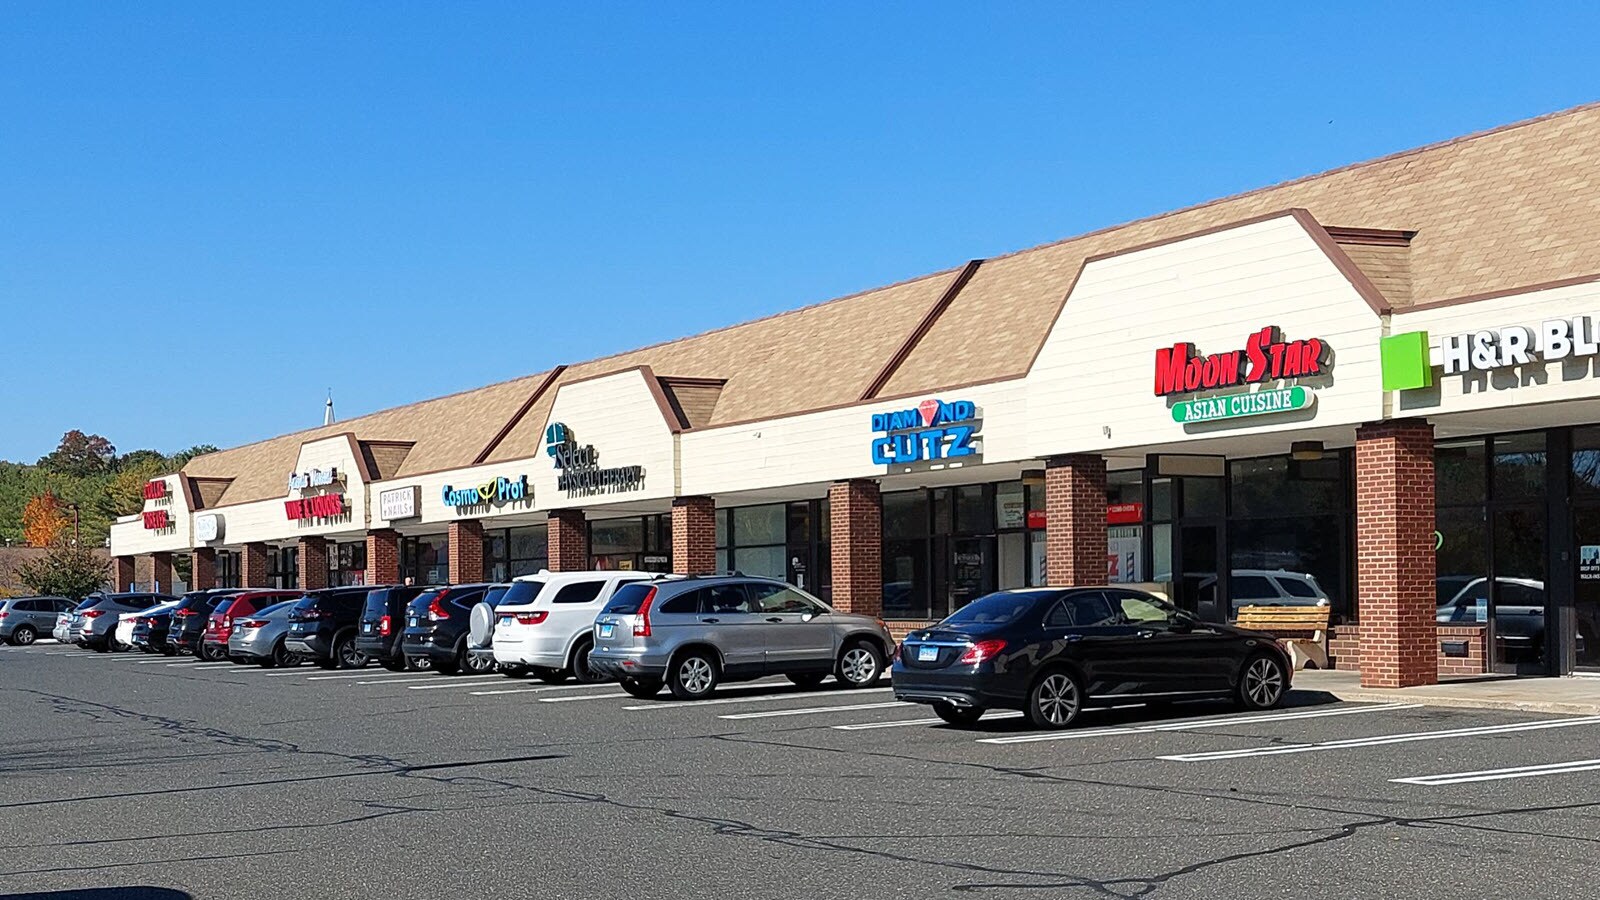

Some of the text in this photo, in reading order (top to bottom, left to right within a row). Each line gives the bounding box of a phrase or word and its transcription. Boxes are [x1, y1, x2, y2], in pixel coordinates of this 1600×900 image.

[1155, 325, 1326, 397] MOON STAR
[1442, 316, 1600, 375] H&R BL
[1184, 390, 1292, 421] ASIAN CUISINE
[555, 441, 594, 470] Select
[872, 425, 975, 465] CUTZ
[441, 474, 526, 507] Cosmo Prof
[557, 465, 641, 491] PHYSICAL THERAPY
[383, 489, 412, 504] PATRICK
[387, 504, 408, 516] NAILS
